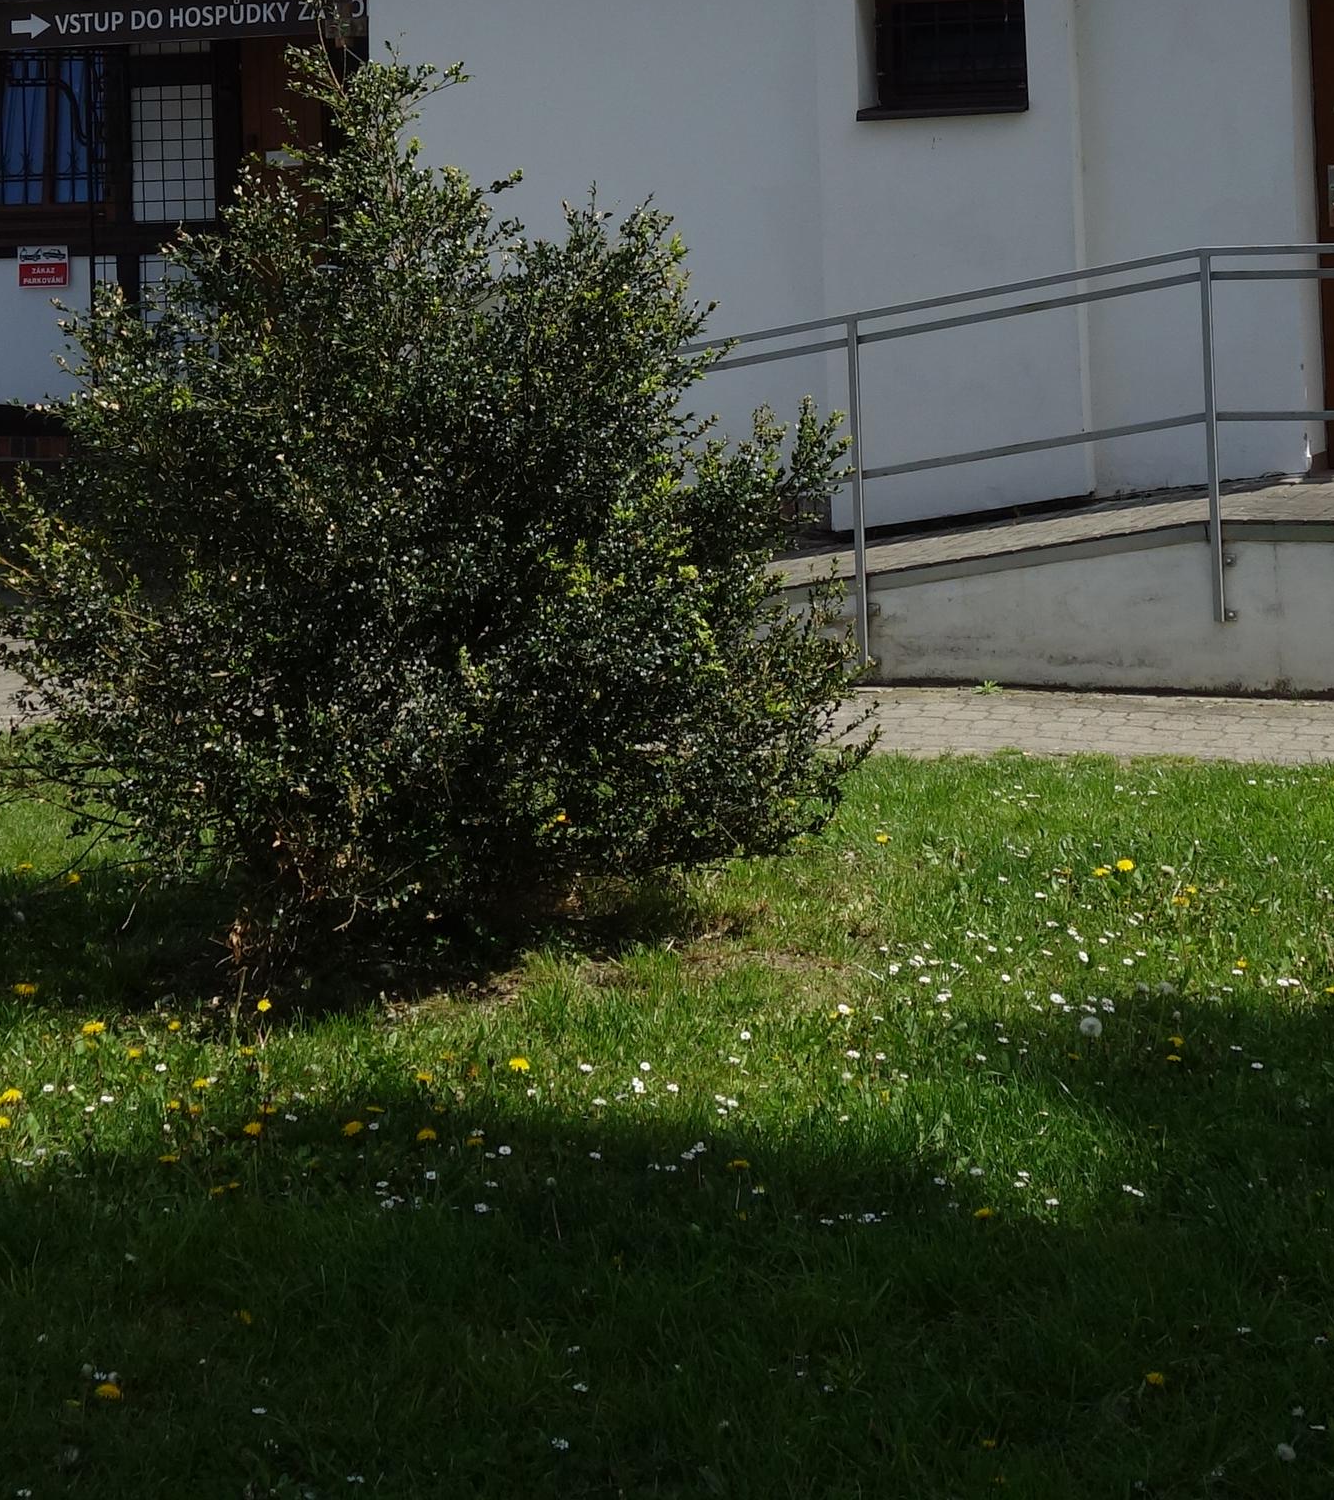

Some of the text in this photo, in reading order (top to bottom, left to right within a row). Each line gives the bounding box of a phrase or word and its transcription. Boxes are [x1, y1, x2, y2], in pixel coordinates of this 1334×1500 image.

[54, 11, 124, 34] VSTUP
[130, 9, 163, 30] DO
[31, 266, 56, 275] ZÁKAZ
[23, 275, 64, 285] PARKOVÁNÍ
